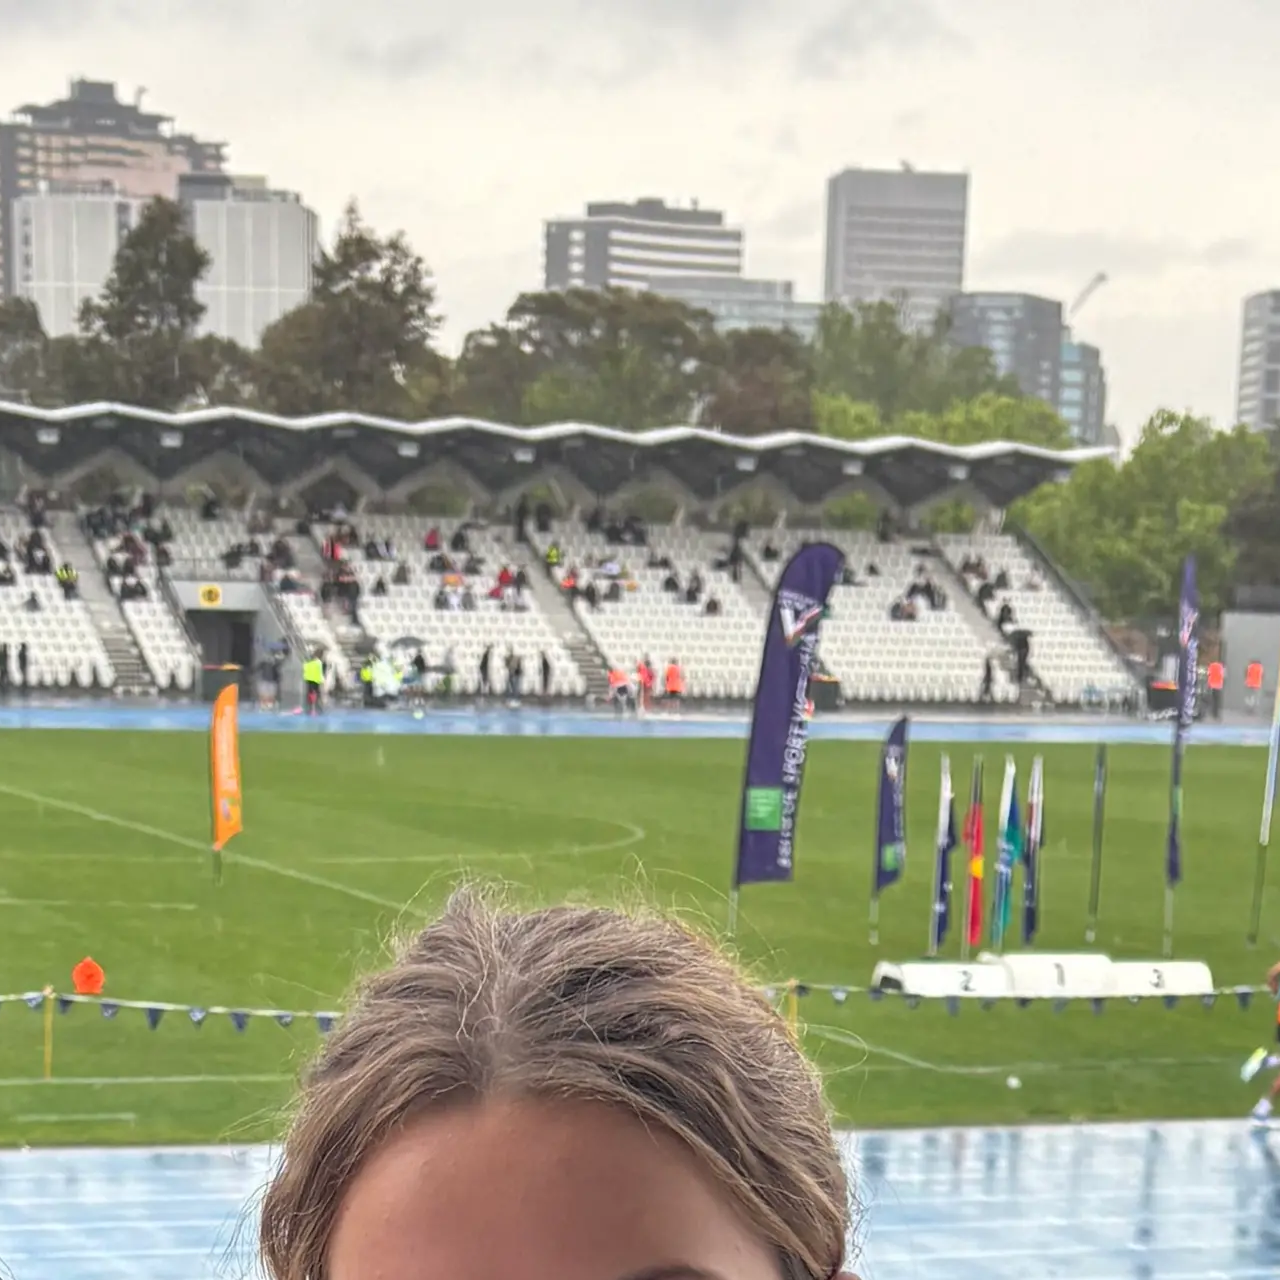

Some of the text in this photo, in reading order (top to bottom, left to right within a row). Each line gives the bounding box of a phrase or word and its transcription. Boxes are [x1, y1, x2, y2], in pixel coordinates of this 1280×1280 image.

[958, 970, 976, 992] 2
[1053, 962, 1065, 987] 1
[1149, 968, 1166, 989] 3
